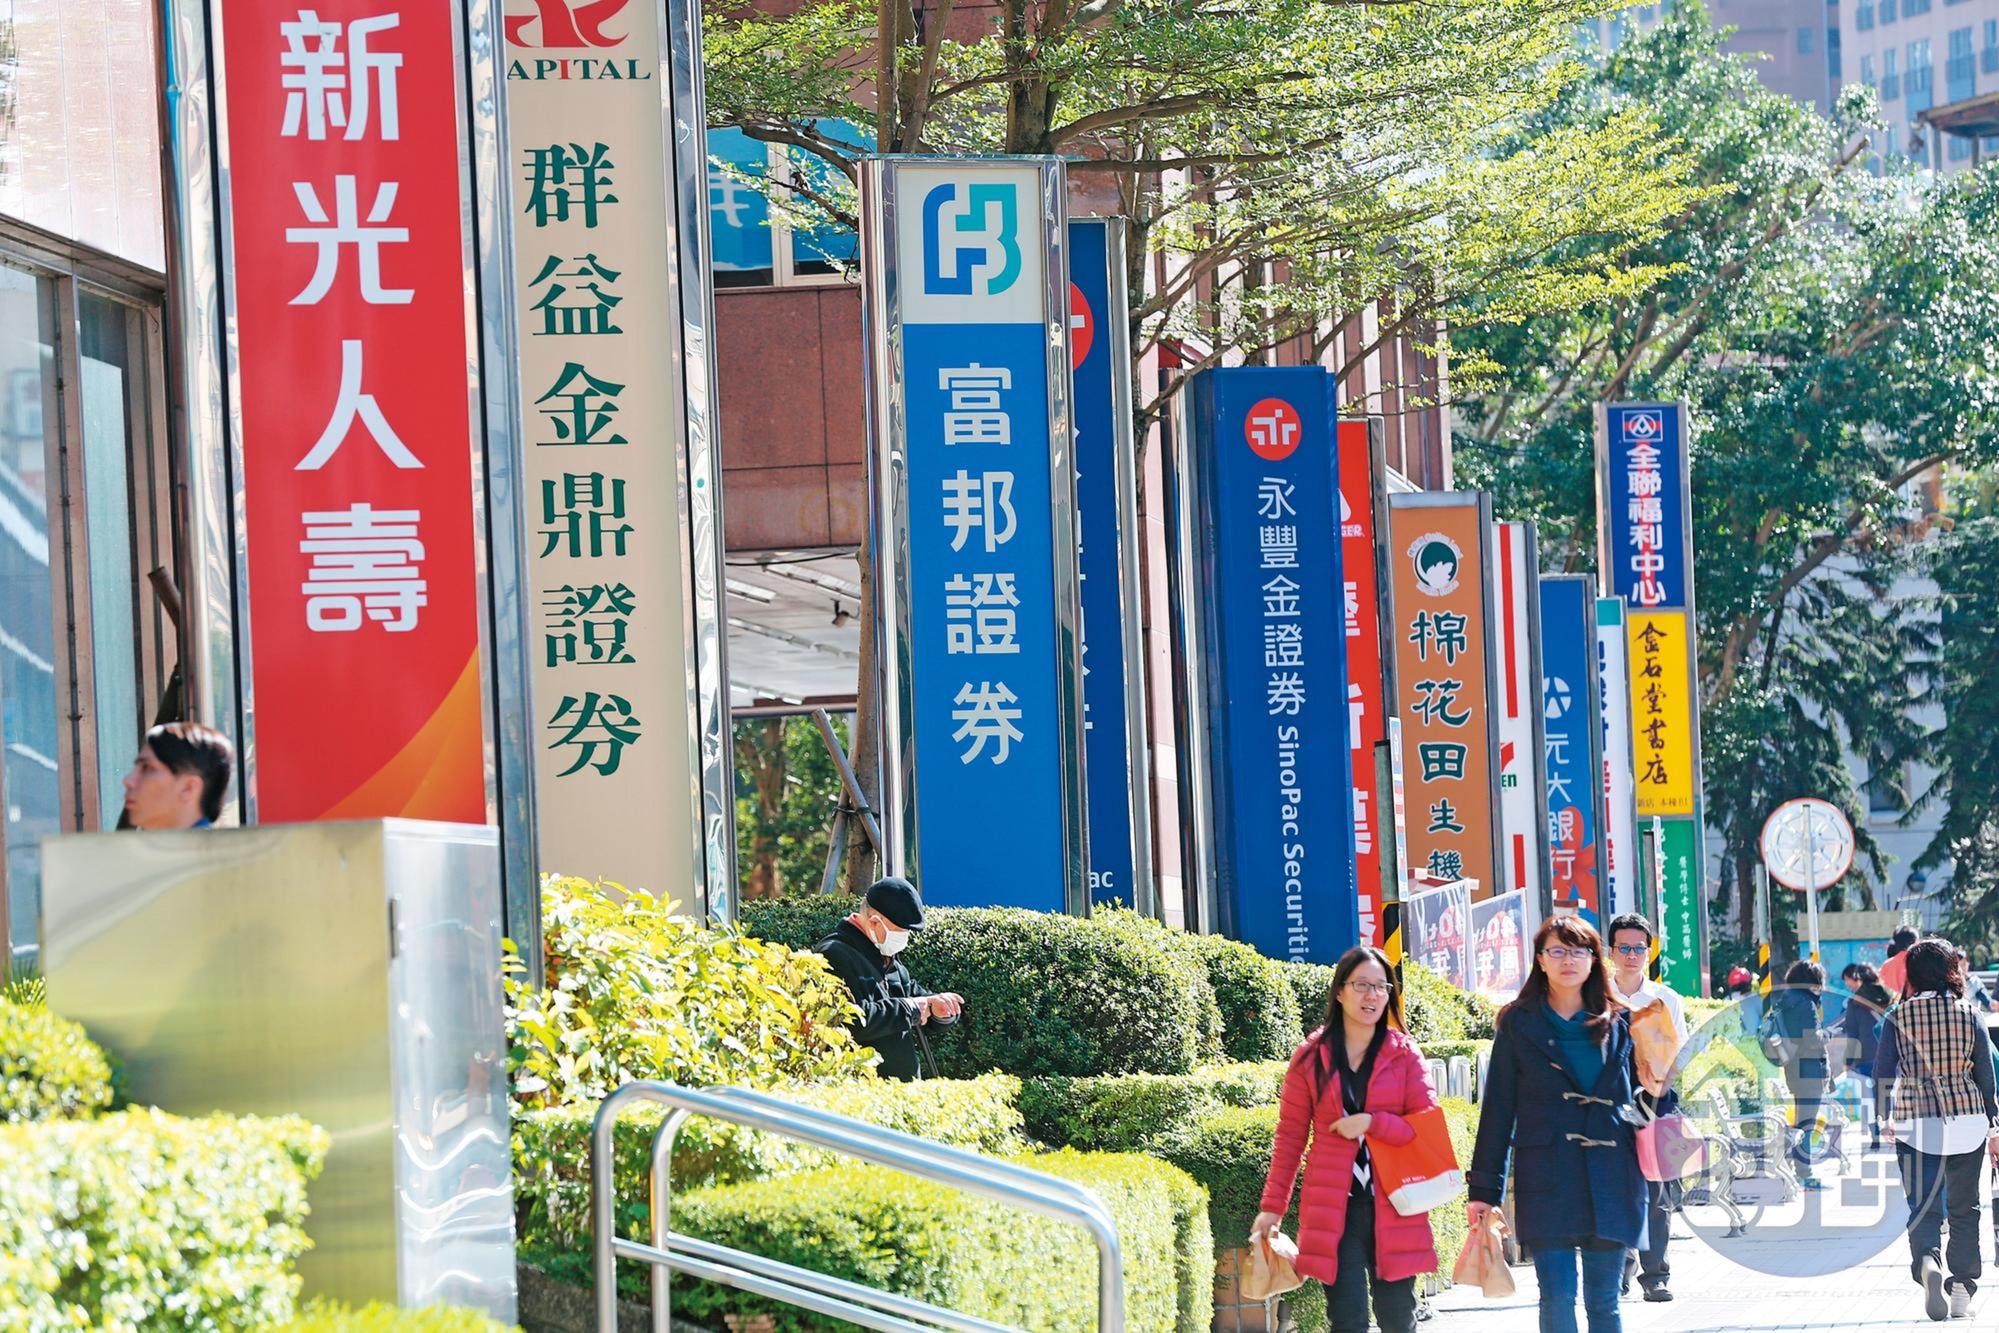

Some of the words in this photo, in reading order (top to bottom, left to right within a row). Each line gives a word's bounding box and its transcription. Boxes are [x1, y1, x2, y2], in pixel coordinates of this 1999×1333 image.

[279, 9, 428, 633] 新光人壽
[523, 142, 643, 778] 群益金鼎證券
[938, 362, 1025, 767] 富邦證券
[1626, 443, 1667, 605] 全聯福利中心
[1257, 476, 1306, 716] 永豐金證券
[1636, 620, 1668, 786] 金石堂書店
[1278, 725, 1302, 837] SinoPac
[1407, 609, 1472, 881] 棉花田生機
[1545, 732, 1576, 881] 元大銀行
